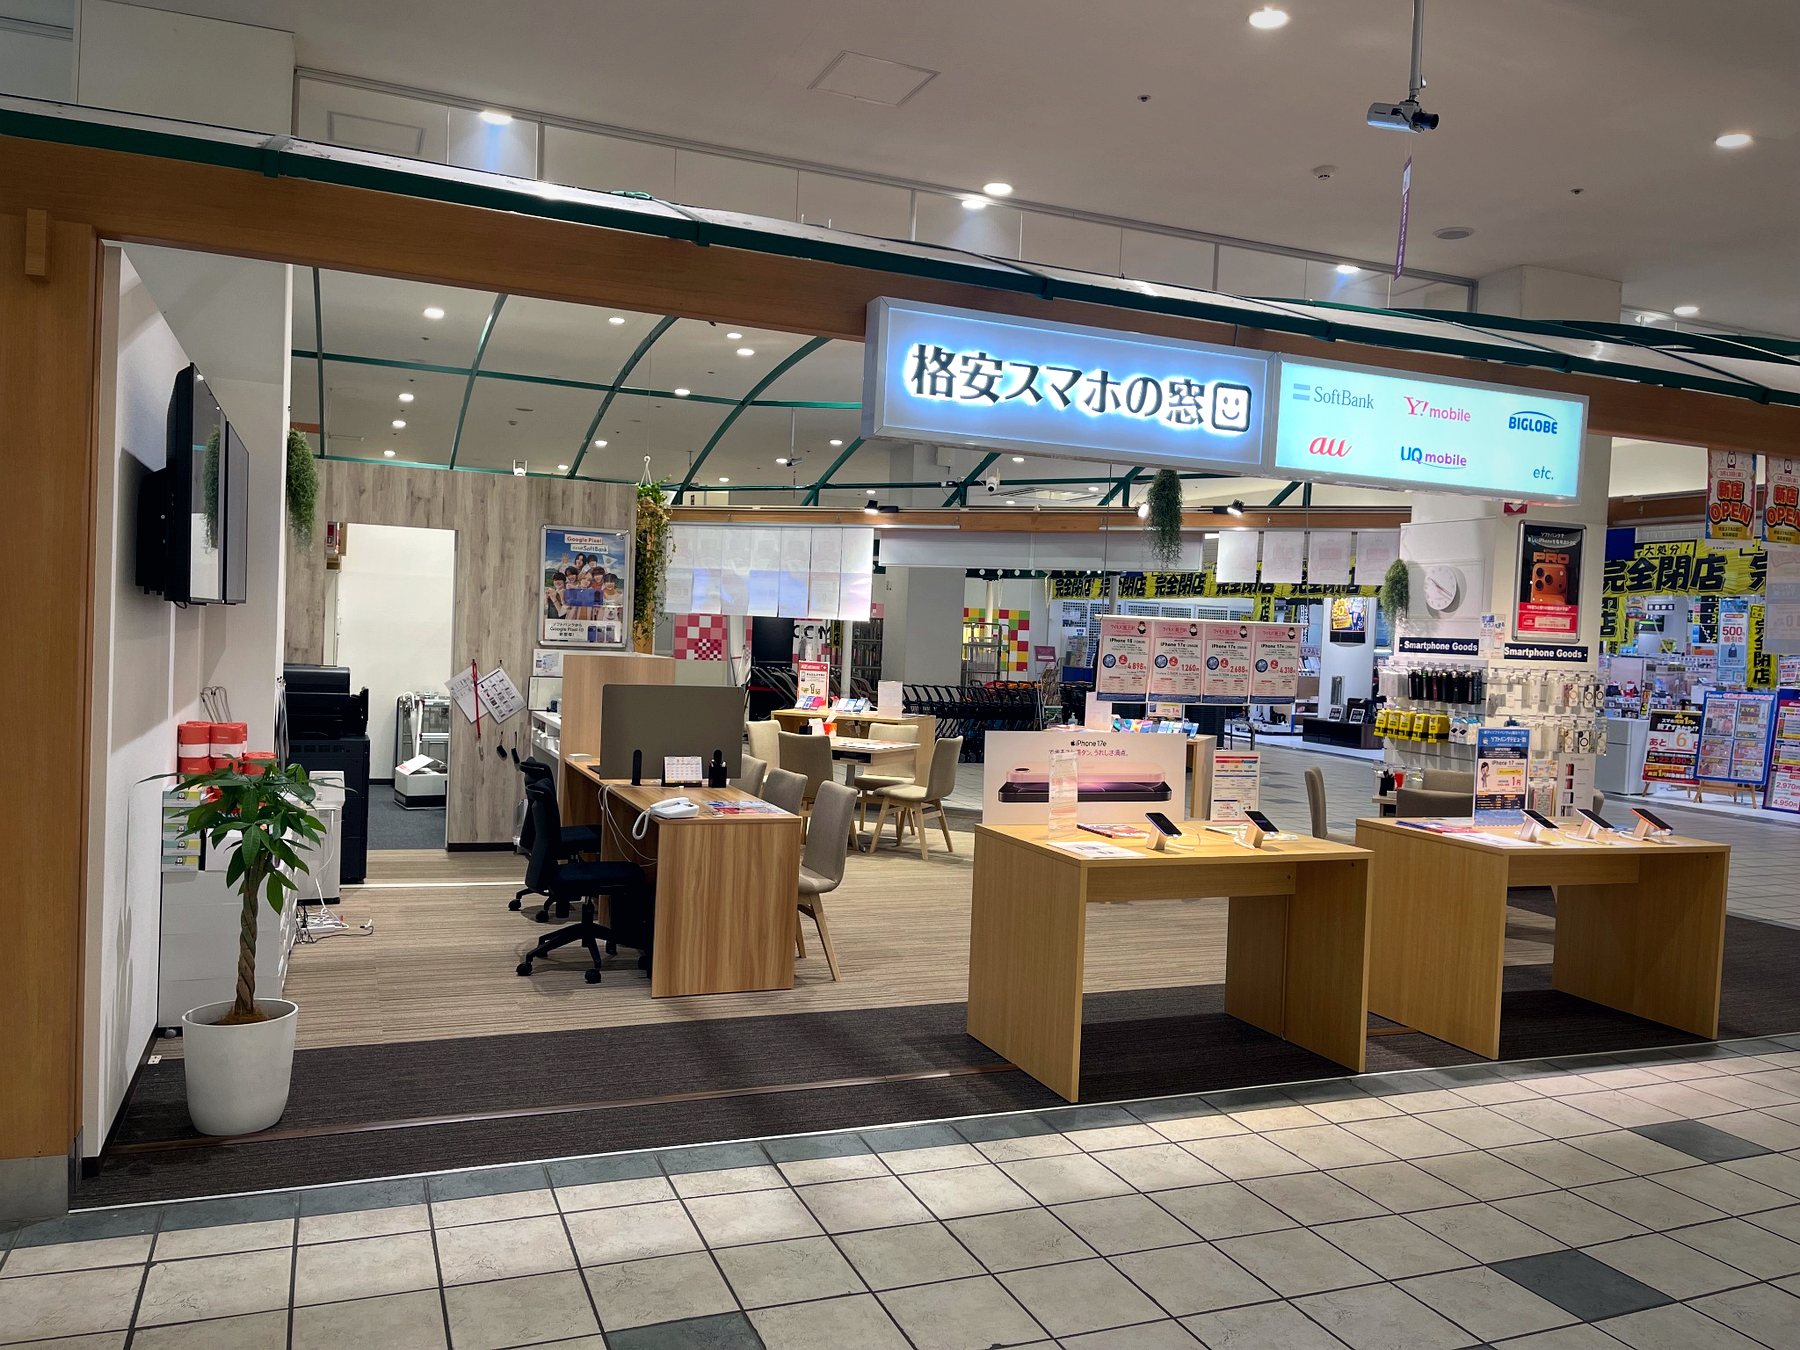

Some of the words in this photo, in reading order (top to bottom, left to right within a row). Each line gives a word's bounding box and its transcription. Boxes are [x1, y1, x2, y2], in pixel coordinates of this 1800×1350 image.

[1314, 386, 1374, 410] SoftBank
[1508, 412, 1558, 435] BIGLOBE
[1308, 435, 1352, 458] au
[1532, 467, 1555, 480] etc.
[1710, 501, 1753, 524] OPEN
[1533, 552, 1569, 563] PRO
[1155, 573, 1206, 596] 完全閉店
[1404, 641, 1450, 652] Smartphone
[1452, 643, 1478, 652] Goods
[1504, 647, 1554, 659] Smartphone
[1556, 649, 1582, 658] Goods
[1076, 739, 1096, 747] iPhone
[1649, 738, 1667, 747] あと
[1676, 732, 1687, 747] 6
